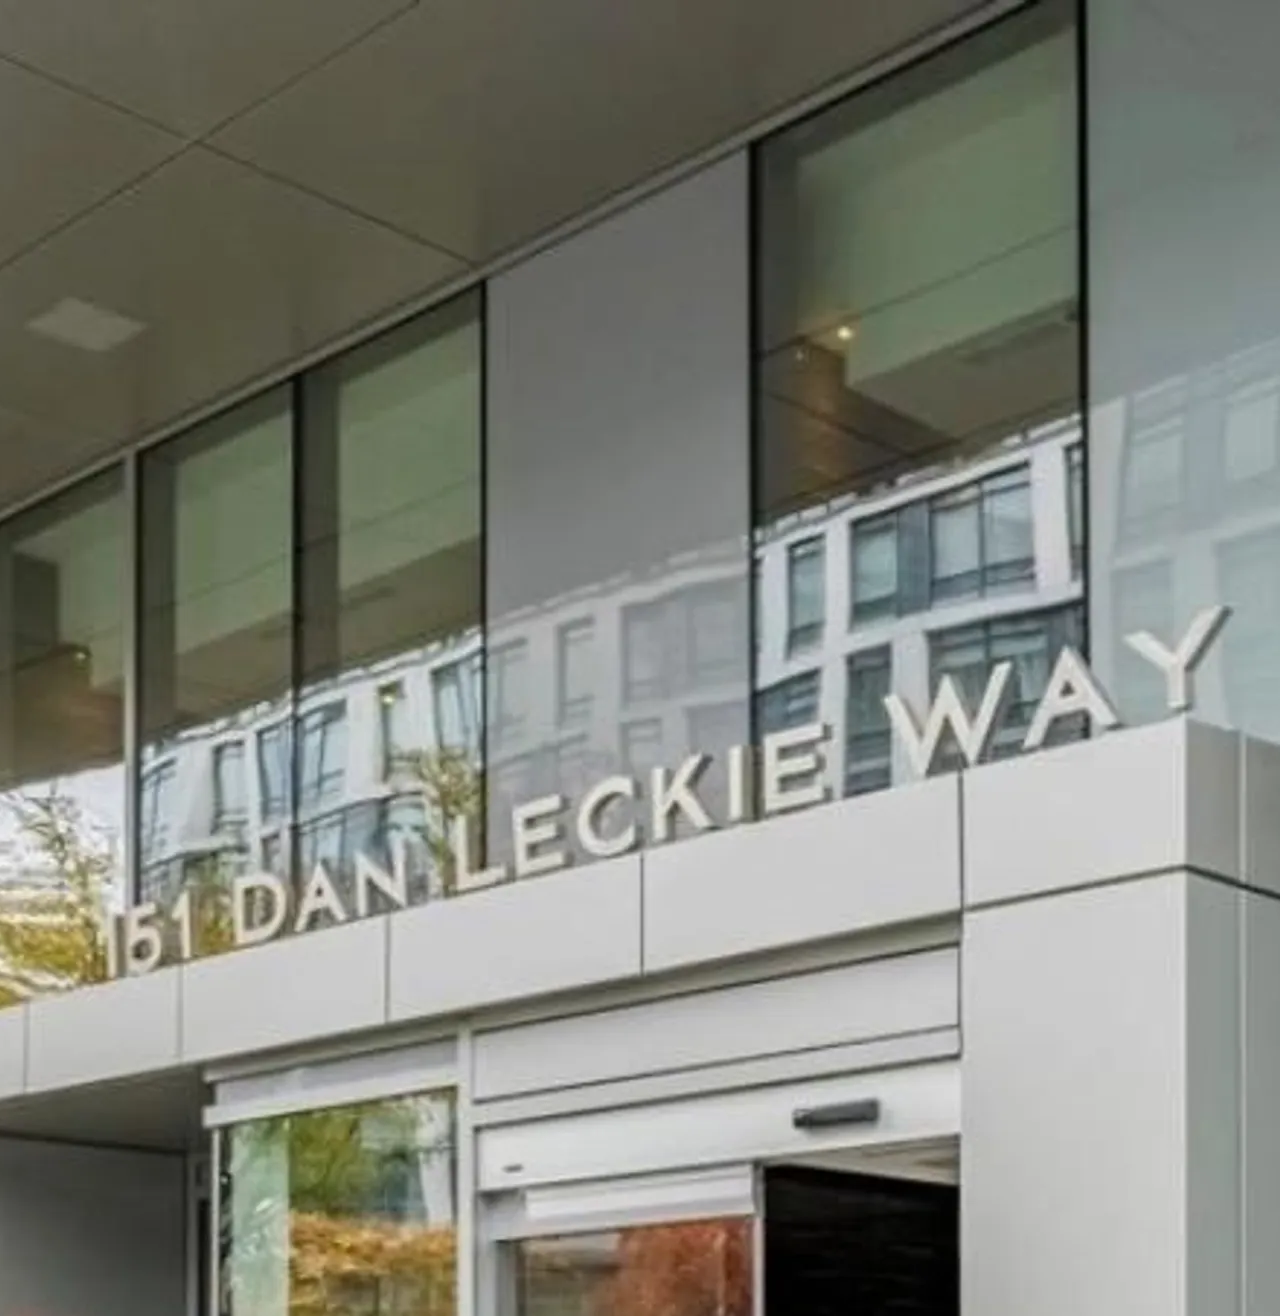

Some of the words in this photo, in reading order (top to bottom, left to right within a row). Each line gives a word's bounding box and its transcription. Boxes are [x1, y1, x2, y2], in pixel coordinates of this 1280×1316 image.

[106, 888, 192, 979] 151
[231, 838, 409, 945] DAN
[454, 722, 829, 892] LECKIE
[884, 604, 1229, 778] WAY
